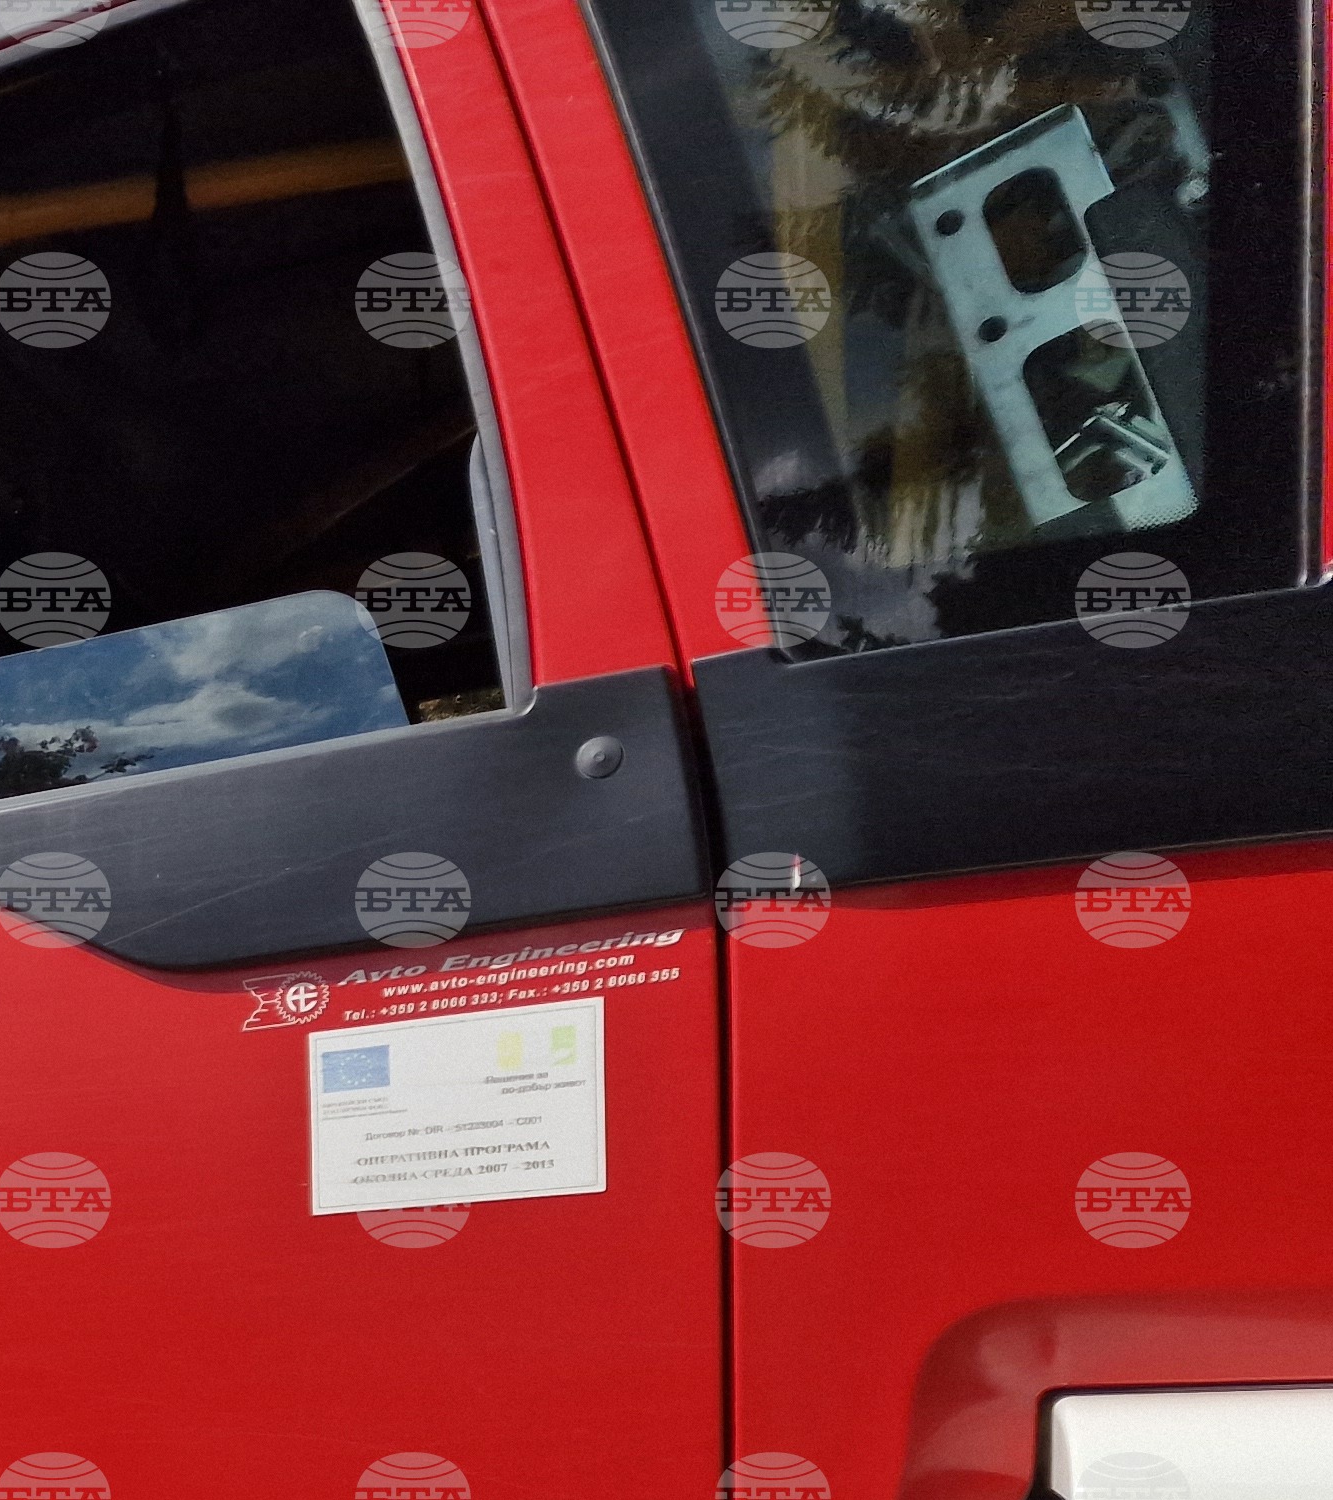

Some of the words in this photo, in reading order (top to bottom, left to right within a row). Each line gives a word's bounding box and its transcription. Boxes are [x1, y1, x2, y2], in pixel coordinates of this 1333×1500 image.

[336, 964, 427, 987] Avto
[439, 928, 687, 973] Engineering
[383, 954, 635, 998] www.avto-engineering.com
[344, 1009, 375, 1022] Tel.:
[418, 1001, 427, 1012] 2
[507, 987, 547, 1001] Fax.:
[593, 978, 603, 990] 2
[650, 967, 680, 983] 355
[355, 1149, 459, 1167] ОПЕРАТИВНА
[464, 1140, 550, 1157] ПРОГРАМА
[422, 1167, 473, 1179] СРЕДА
[478, 1163, 508, 1174] 2007
